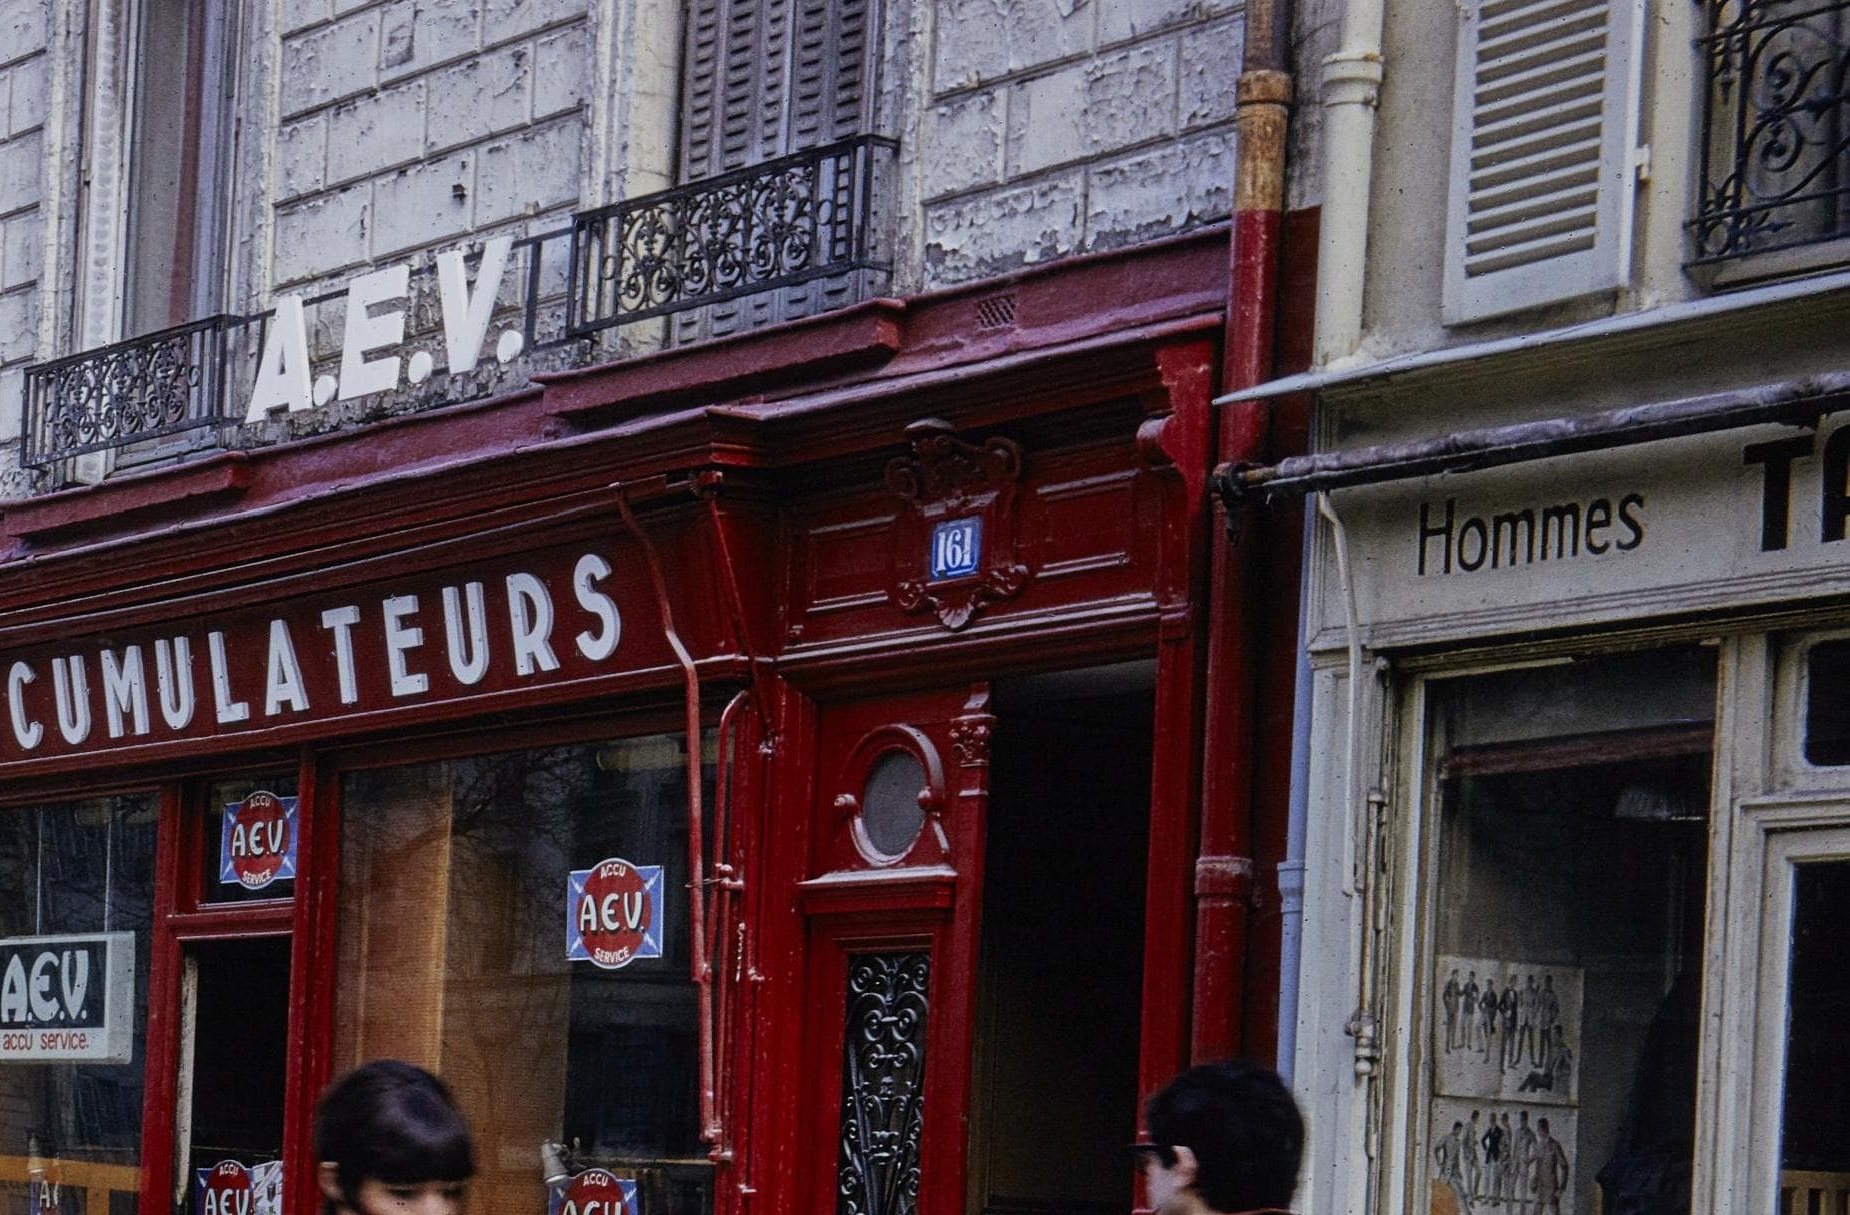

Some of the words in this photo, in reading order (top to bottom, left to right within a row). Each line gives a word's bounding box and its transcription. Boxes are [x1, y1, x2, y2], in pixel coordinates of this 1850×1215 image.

[246, 236, 523, 423] A.E.V.
[1418, 493, 1644, 577] Hommes
[936, 527, 971, 571] 161
[250, 795, 271, 809] ACCU
[242, 868, 271, 885] SERVICE
[600, 863, 626, 879] ACCU
[594, 946, 629, 963] SERVICE
[3, 1032, 32, 1050] accu
[219, 1163, 239, 1177] ACCU
[582, 1173, 609, 1187] ACCU
